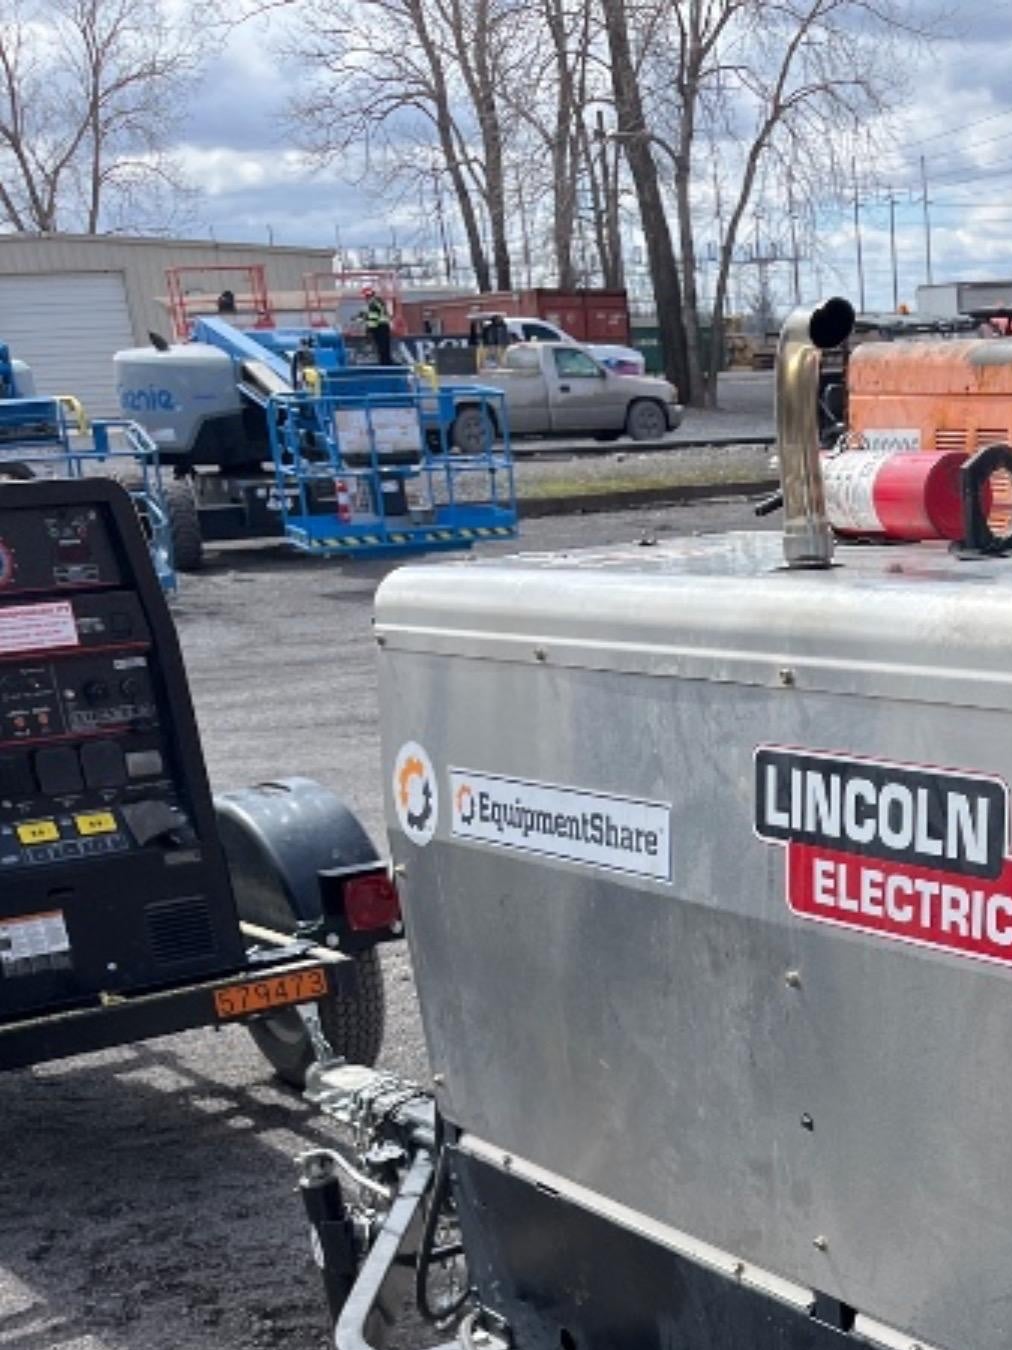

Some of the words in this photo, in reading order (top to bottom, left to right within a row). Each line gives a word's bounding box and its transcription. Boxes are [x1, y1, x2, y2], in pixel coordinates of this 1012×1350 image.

[479, 791, 659, 857] EquipmentShare
[765, 763, 991, 865] LINCOLN
[218, 971, 324, 1014] 579473
